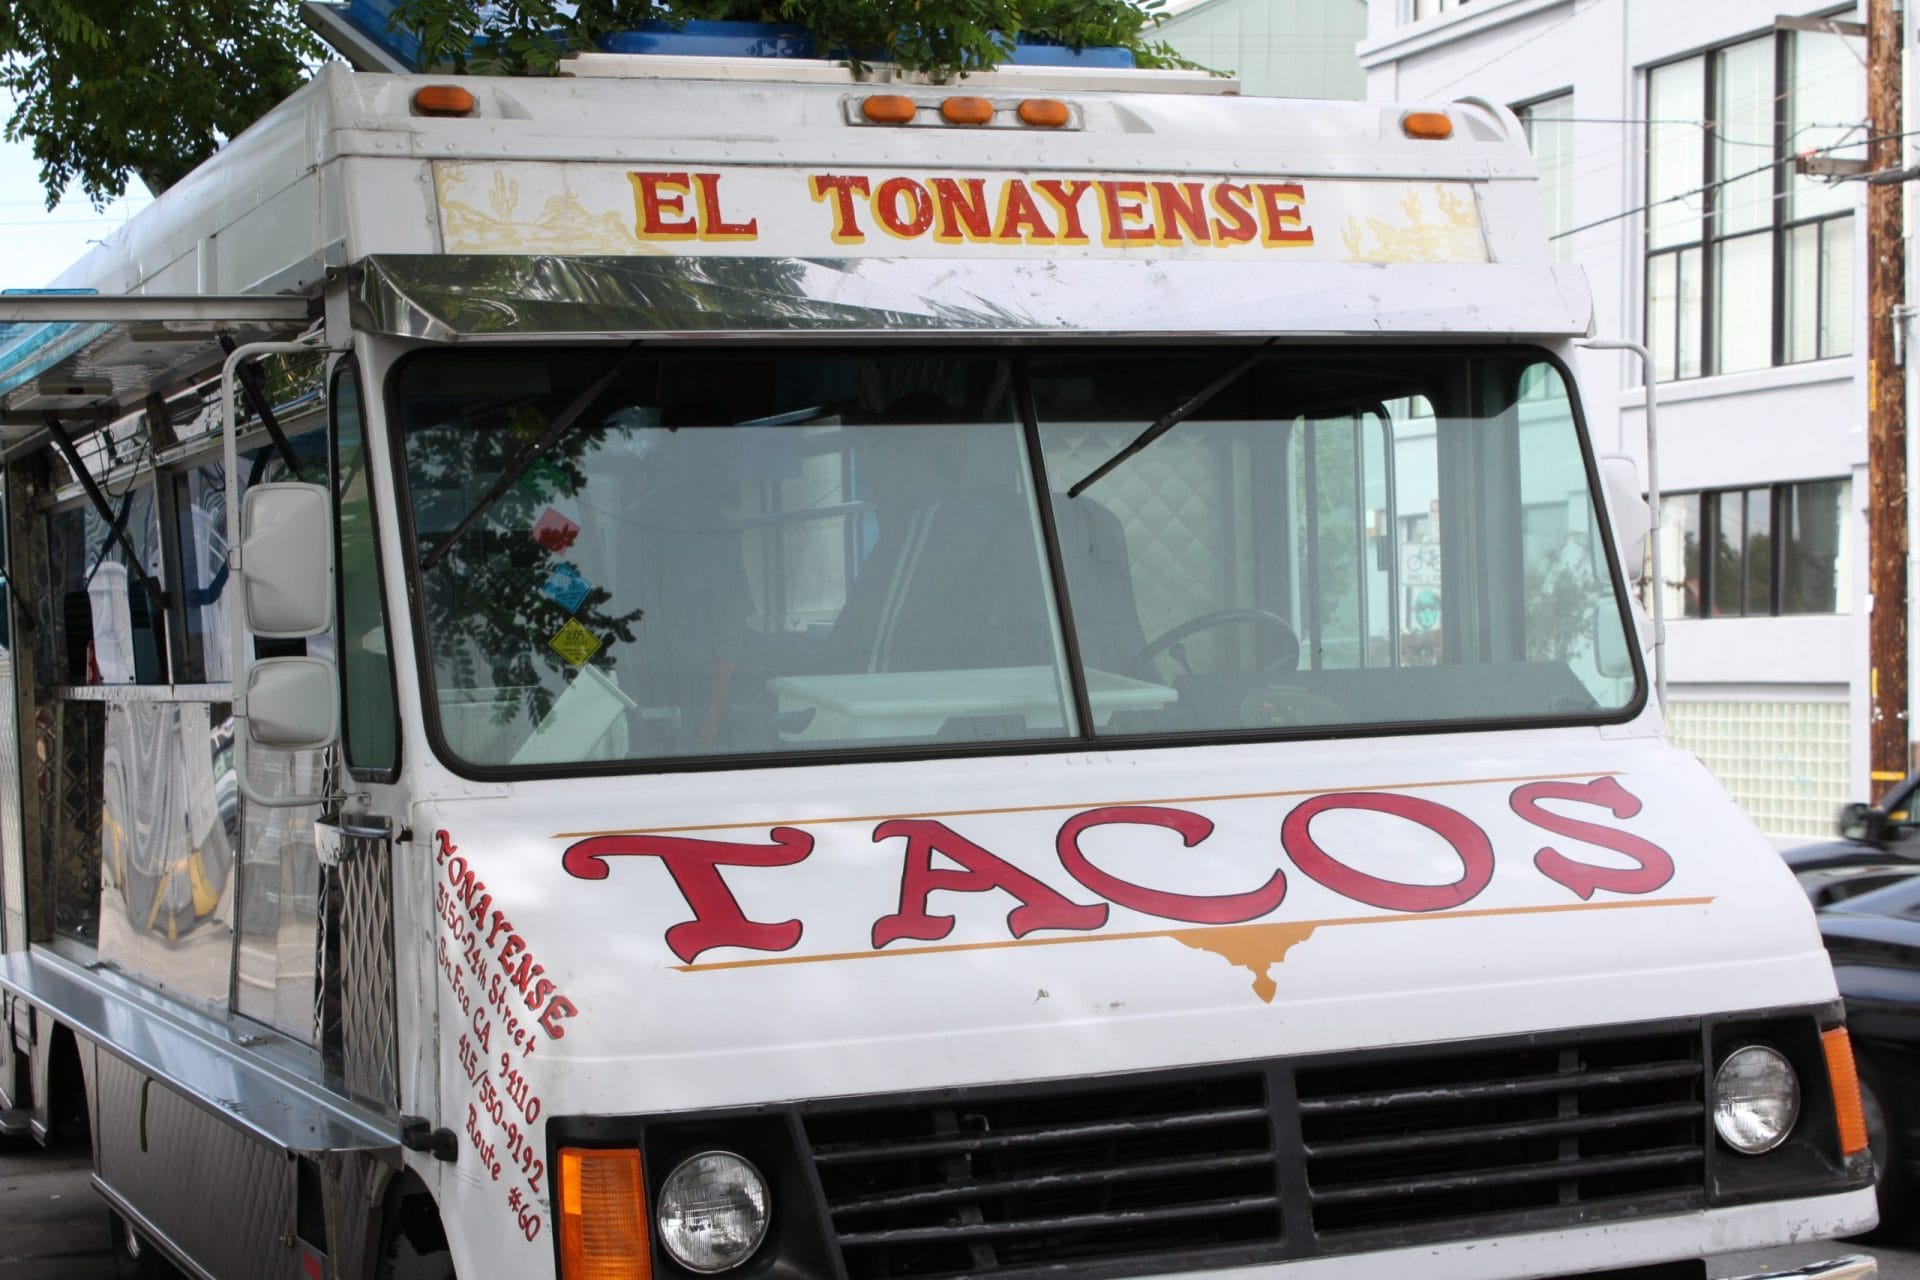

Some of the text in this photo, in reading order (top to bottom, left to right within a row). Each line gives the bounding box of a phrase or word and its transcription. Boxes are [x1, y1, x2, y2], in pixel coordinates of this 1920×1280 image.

[628, 171, 1314, 248] EL TONAYENSE
[436, 829, 579, 1040] TONAYENSE
[562, 775, 1674, 965] TACOS
[473, 1006, 492, 1054] CA
[499, 1052, 540, 1125] 94110
[489, 973, 536, 1058] Street
[458, 1032, 544, 1194] 415/550-9192
[466, 1102, 541, 1242] Route #60
